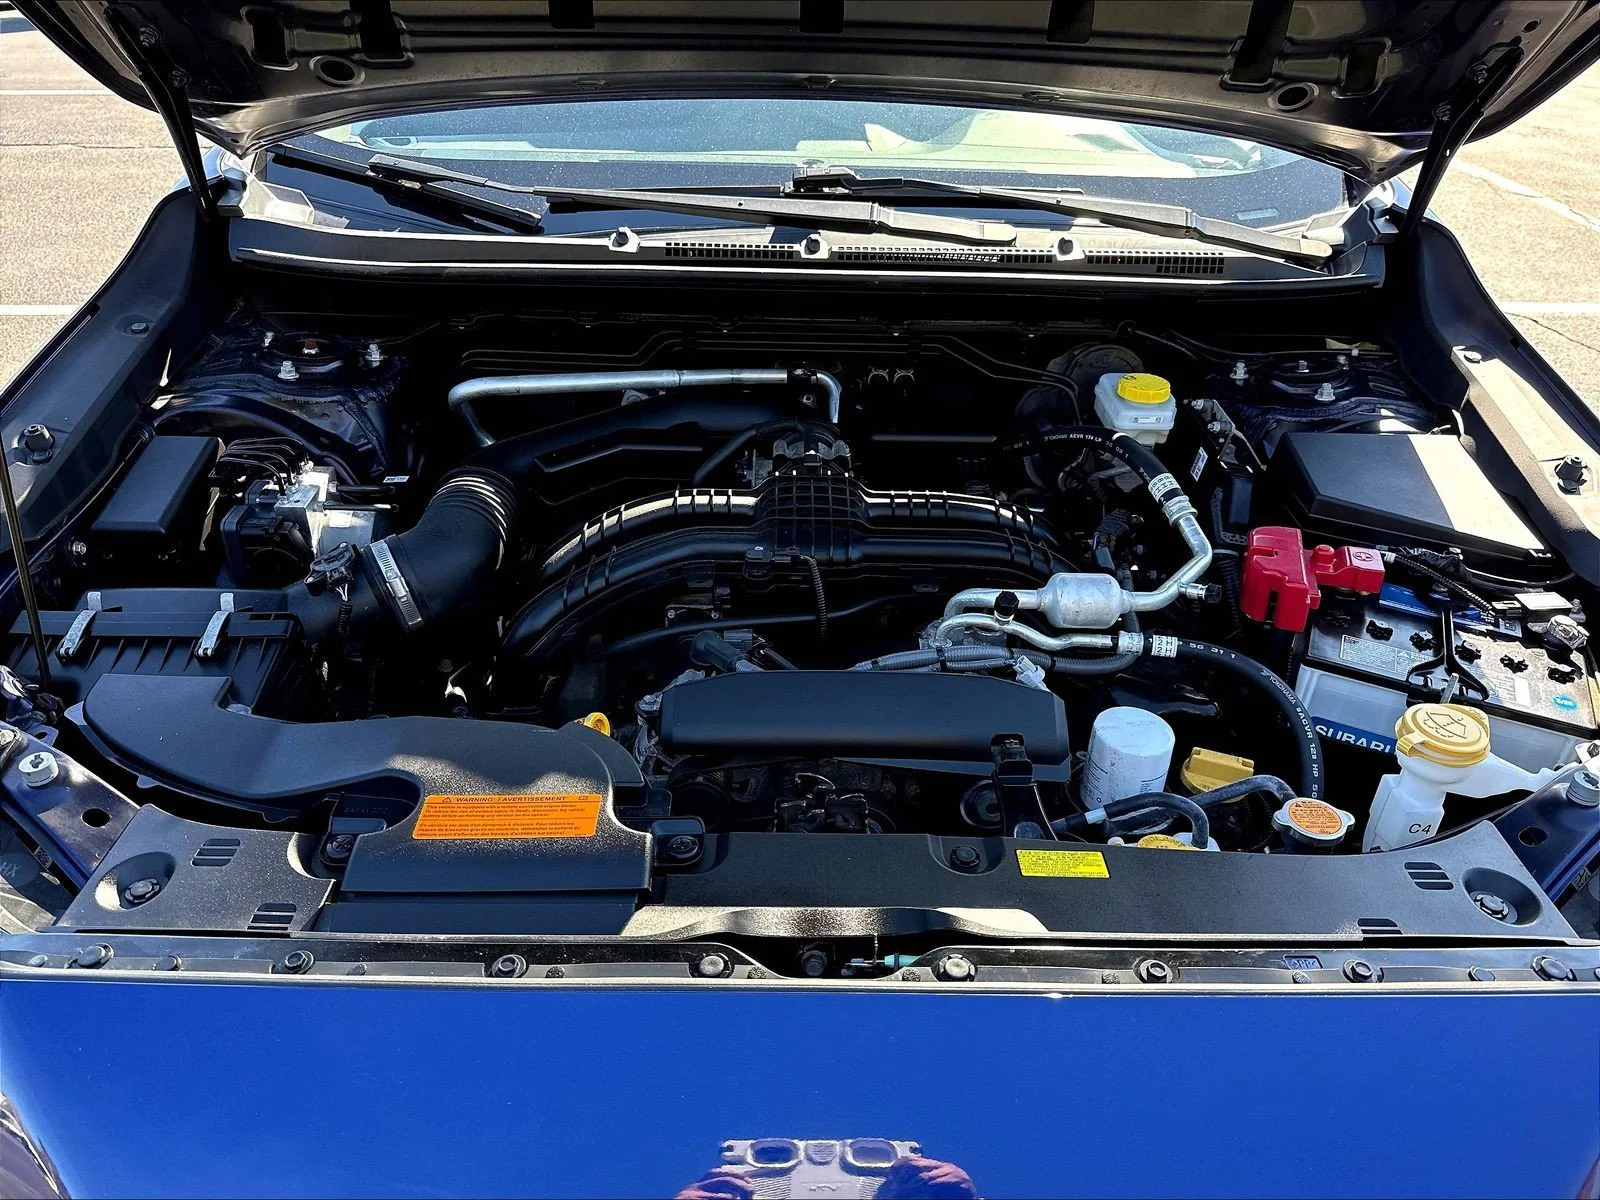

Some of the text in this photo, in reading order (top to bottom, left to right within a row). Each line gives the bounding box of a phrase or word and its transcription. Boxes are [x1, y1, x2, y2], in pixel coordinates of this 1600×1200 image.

[1269, 675, 1297, 704] YOKOHAMA
[1312, 764, 1319, 777] HP
[1409, 823, 1432, 835] C4
